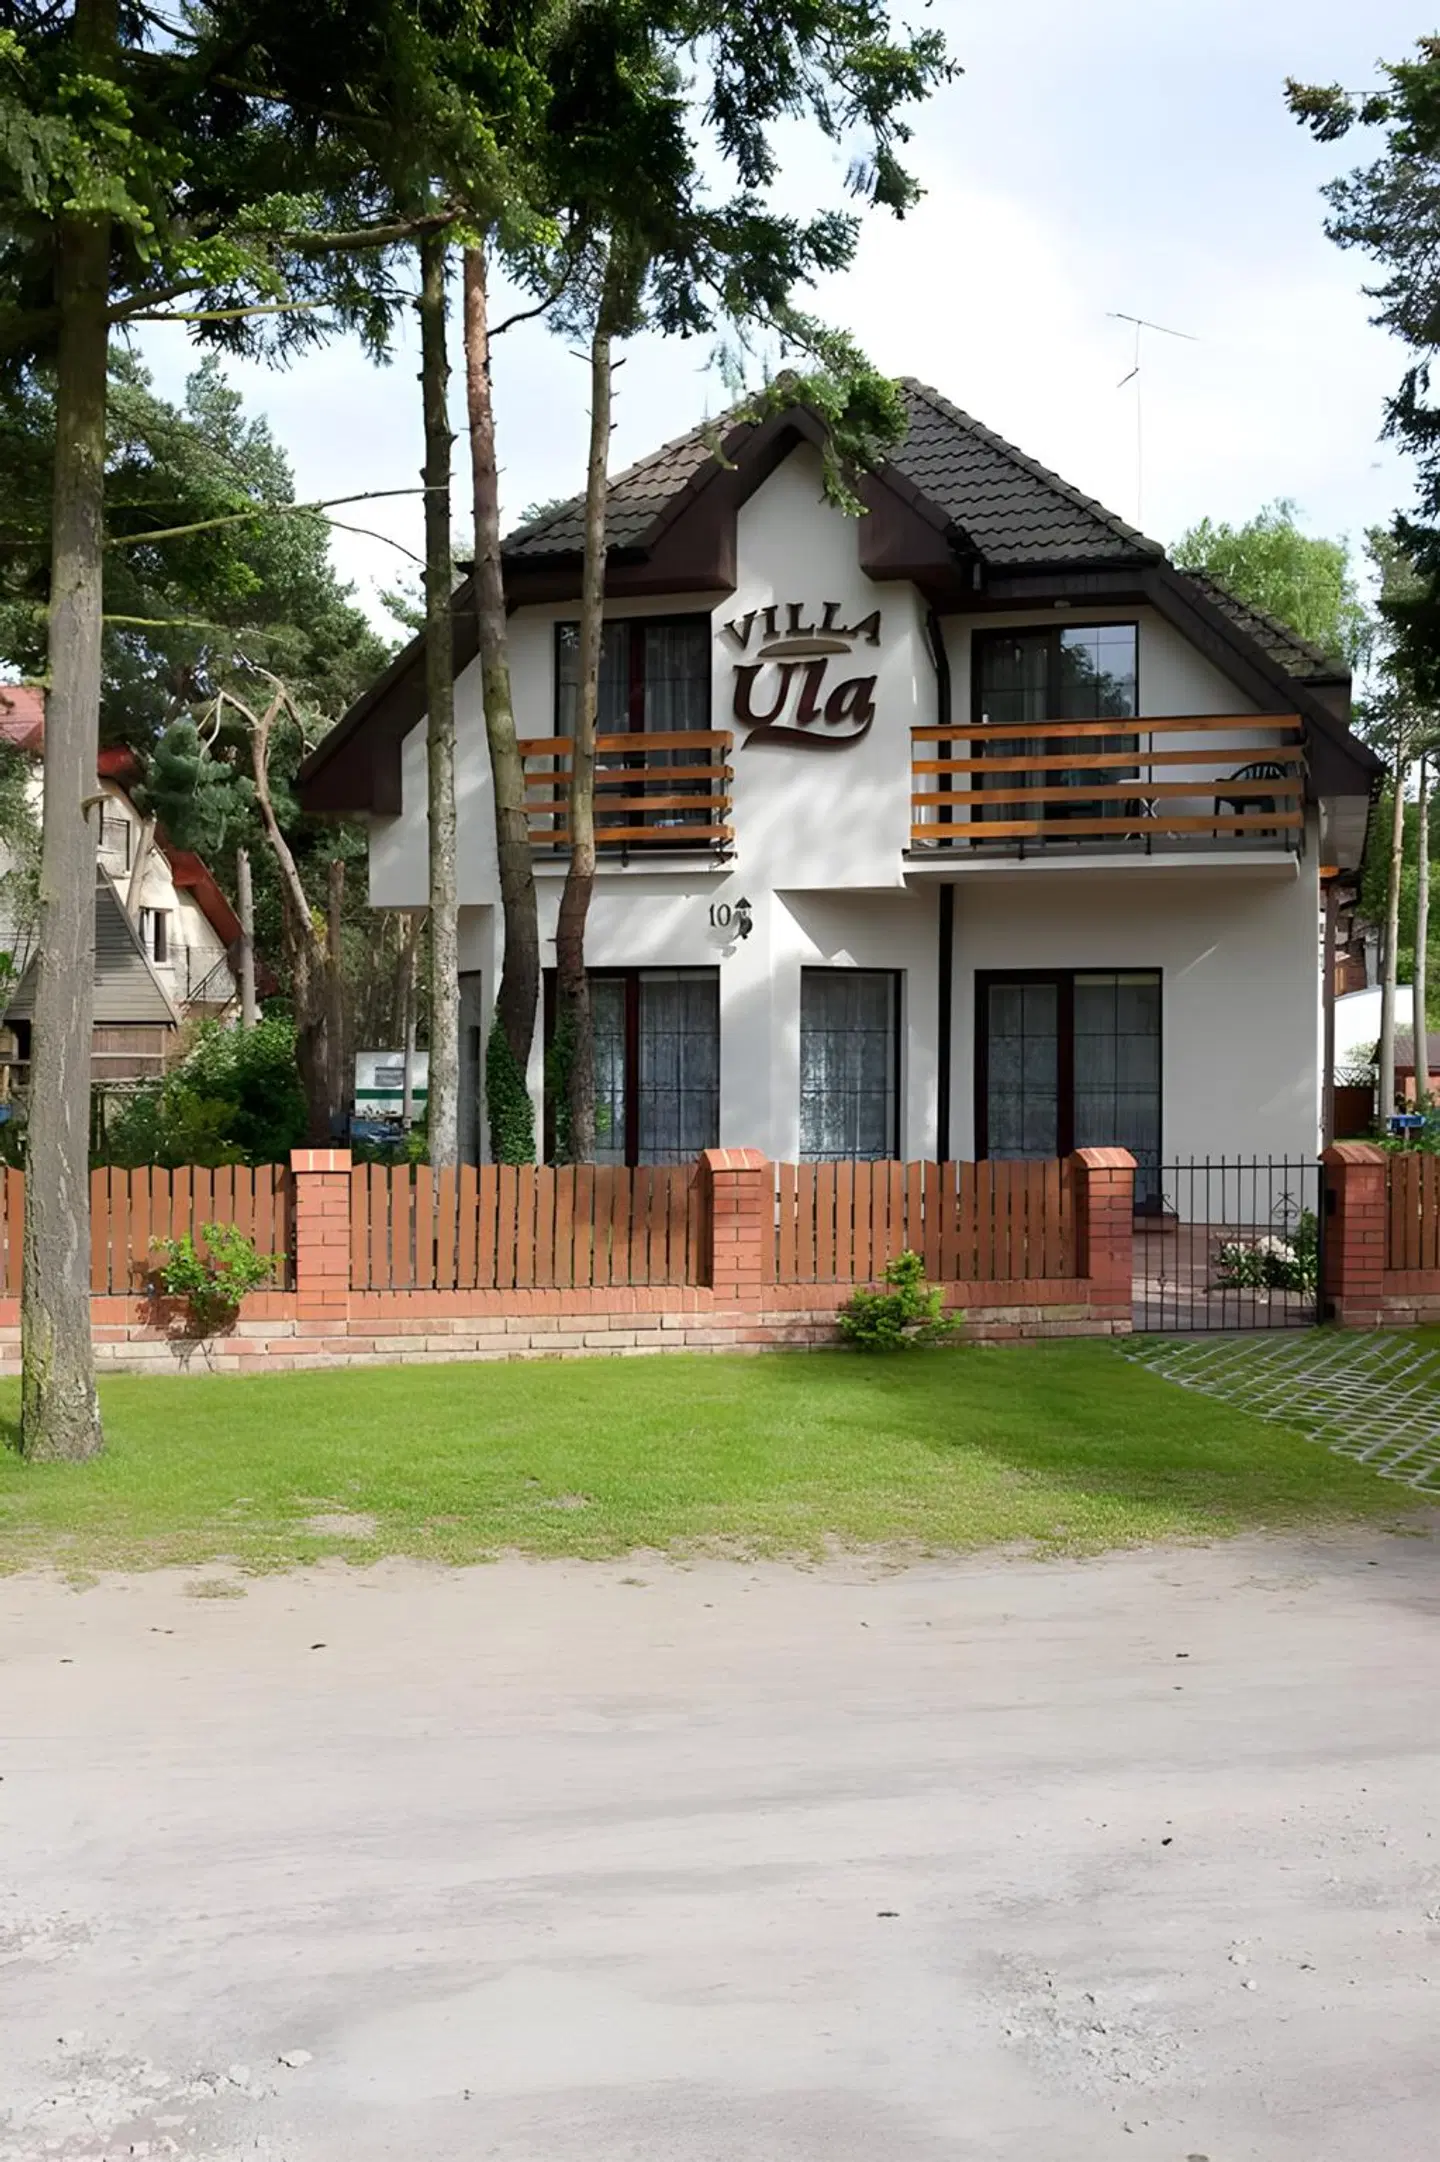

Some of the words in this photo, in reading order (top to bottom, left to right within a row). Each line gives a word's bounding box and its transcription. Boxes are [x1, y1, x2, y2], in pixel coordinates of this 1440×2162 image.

[724, 602, 881, 648] VILLA
[733, 657, 878, 751] Ula
[709, 903, 731, 927] 10
